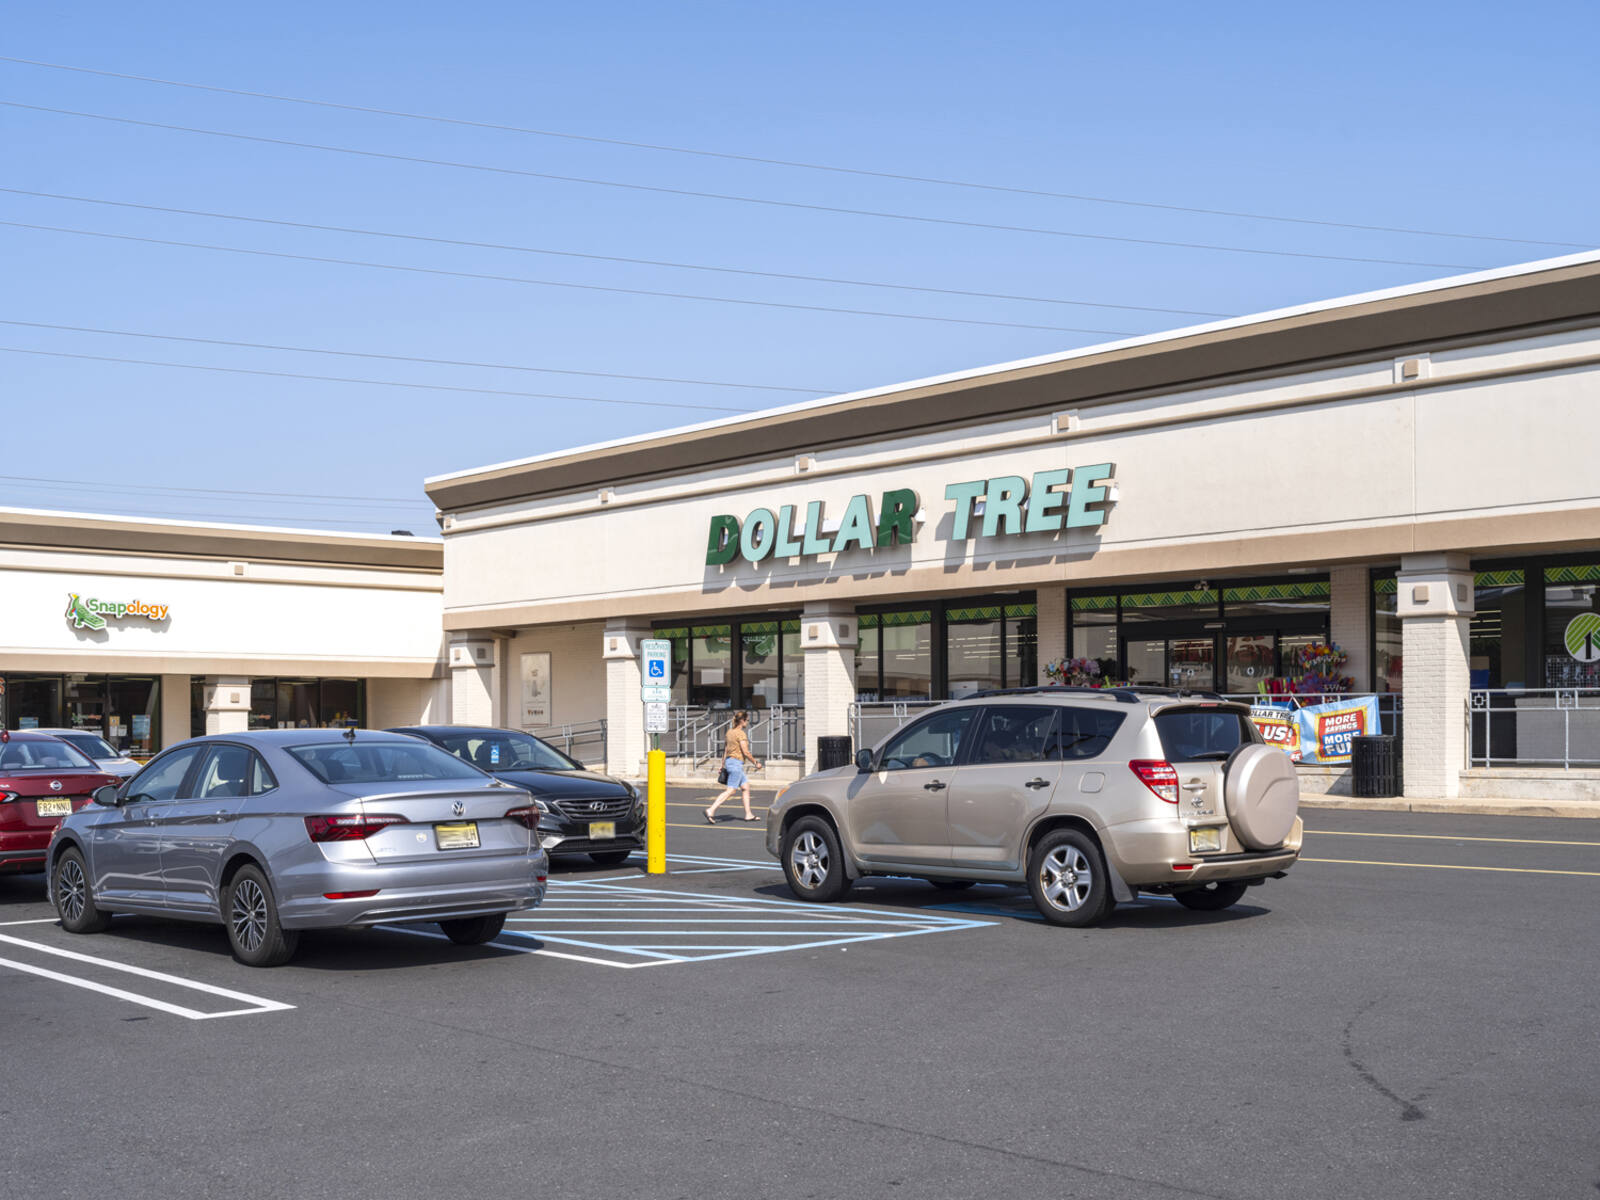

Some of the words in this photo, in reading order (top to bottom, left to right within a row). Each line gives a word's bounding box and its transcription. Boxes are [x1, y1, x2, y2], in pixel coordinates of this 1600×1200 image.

[706, 488, 918, 566] DOLLAR
[945, 463, 1115, 541] TREE
[88, 598, 169, 618] Snapology
[1250, 710, 1273, 718] OLLAR
[1325, 713, 1357, 727] MORE
